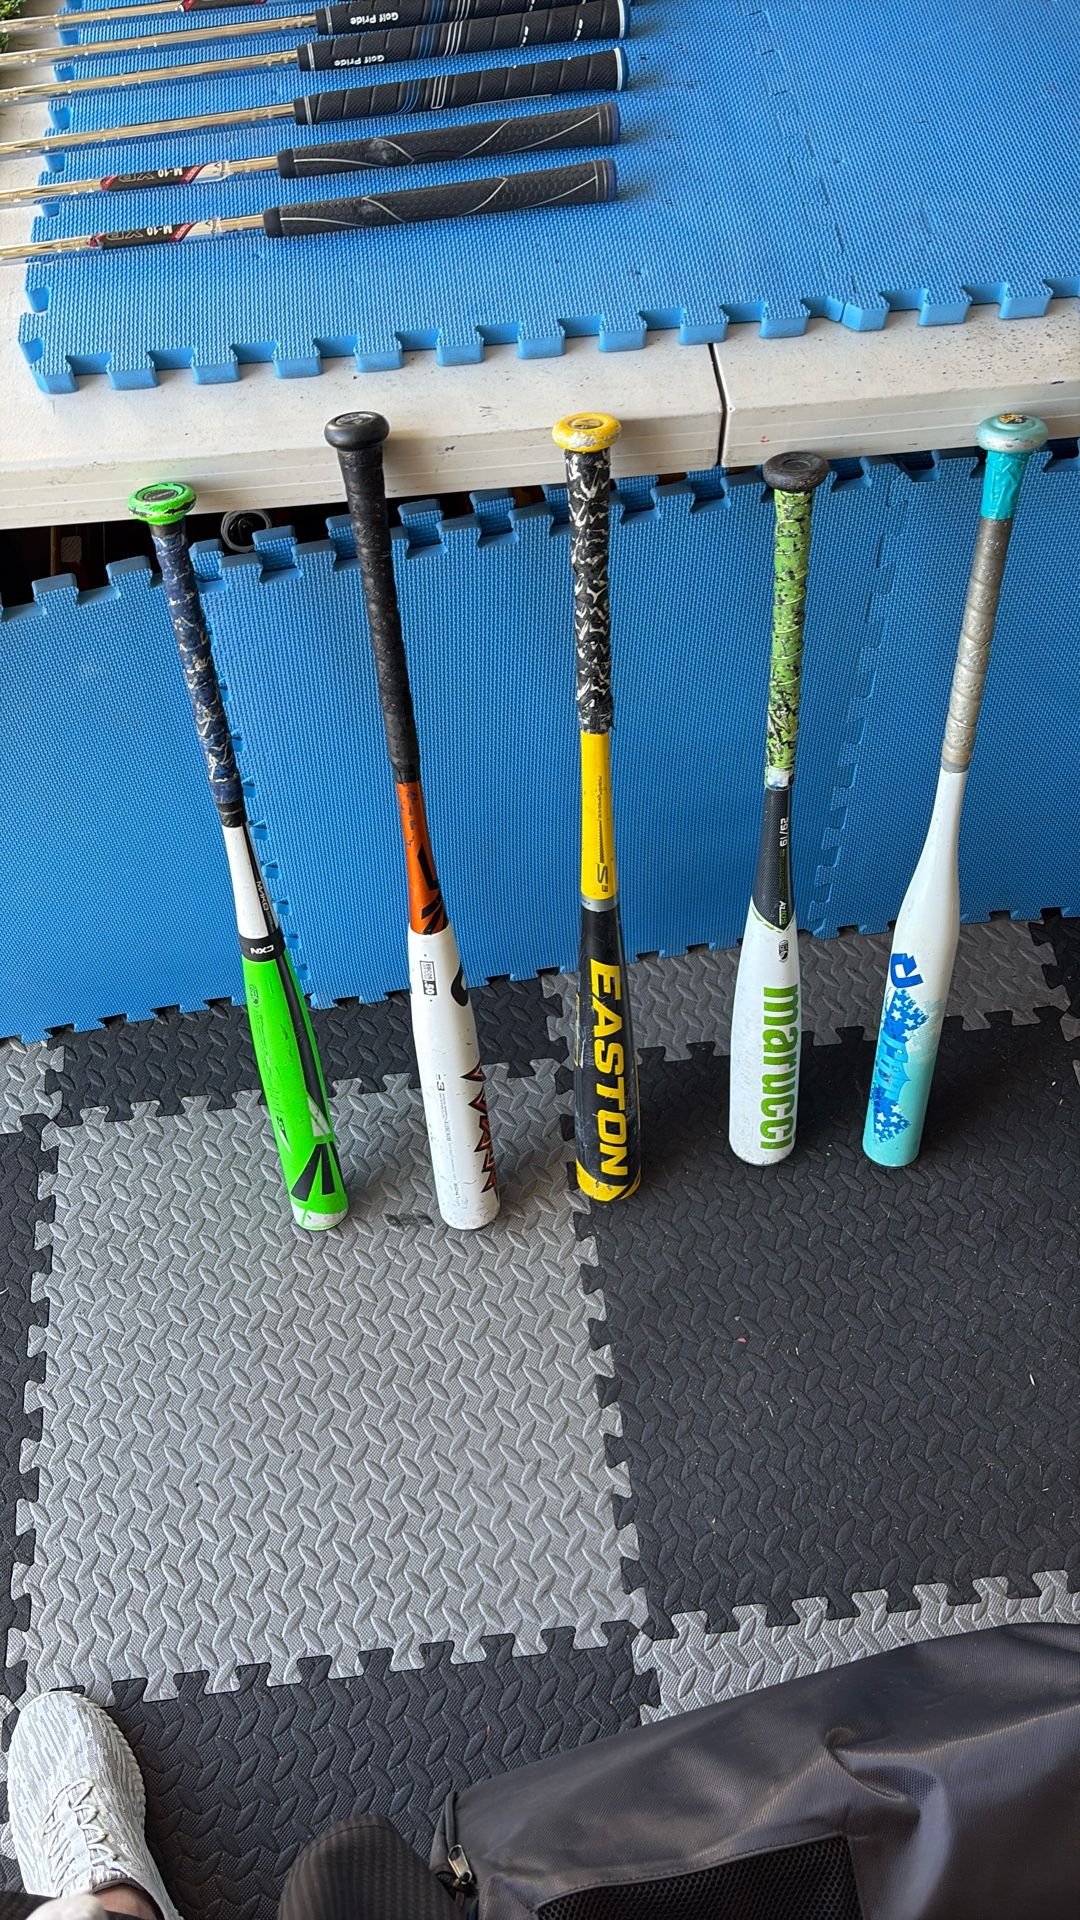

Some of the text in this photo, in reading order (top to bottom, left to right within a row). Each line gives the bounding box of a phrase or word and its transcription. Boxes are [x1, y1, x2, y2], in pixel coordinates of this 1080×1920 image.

[350, 12, 399, 25] Golf Pride
[334, 54, 385, 67] Golf Pride
[779, 816, 789, 847] 29/19
[255, 880, 270, 911] MAKO
[590, 958, 628, 1177] EASTON
[760, 983, 799, 1150] marucci
